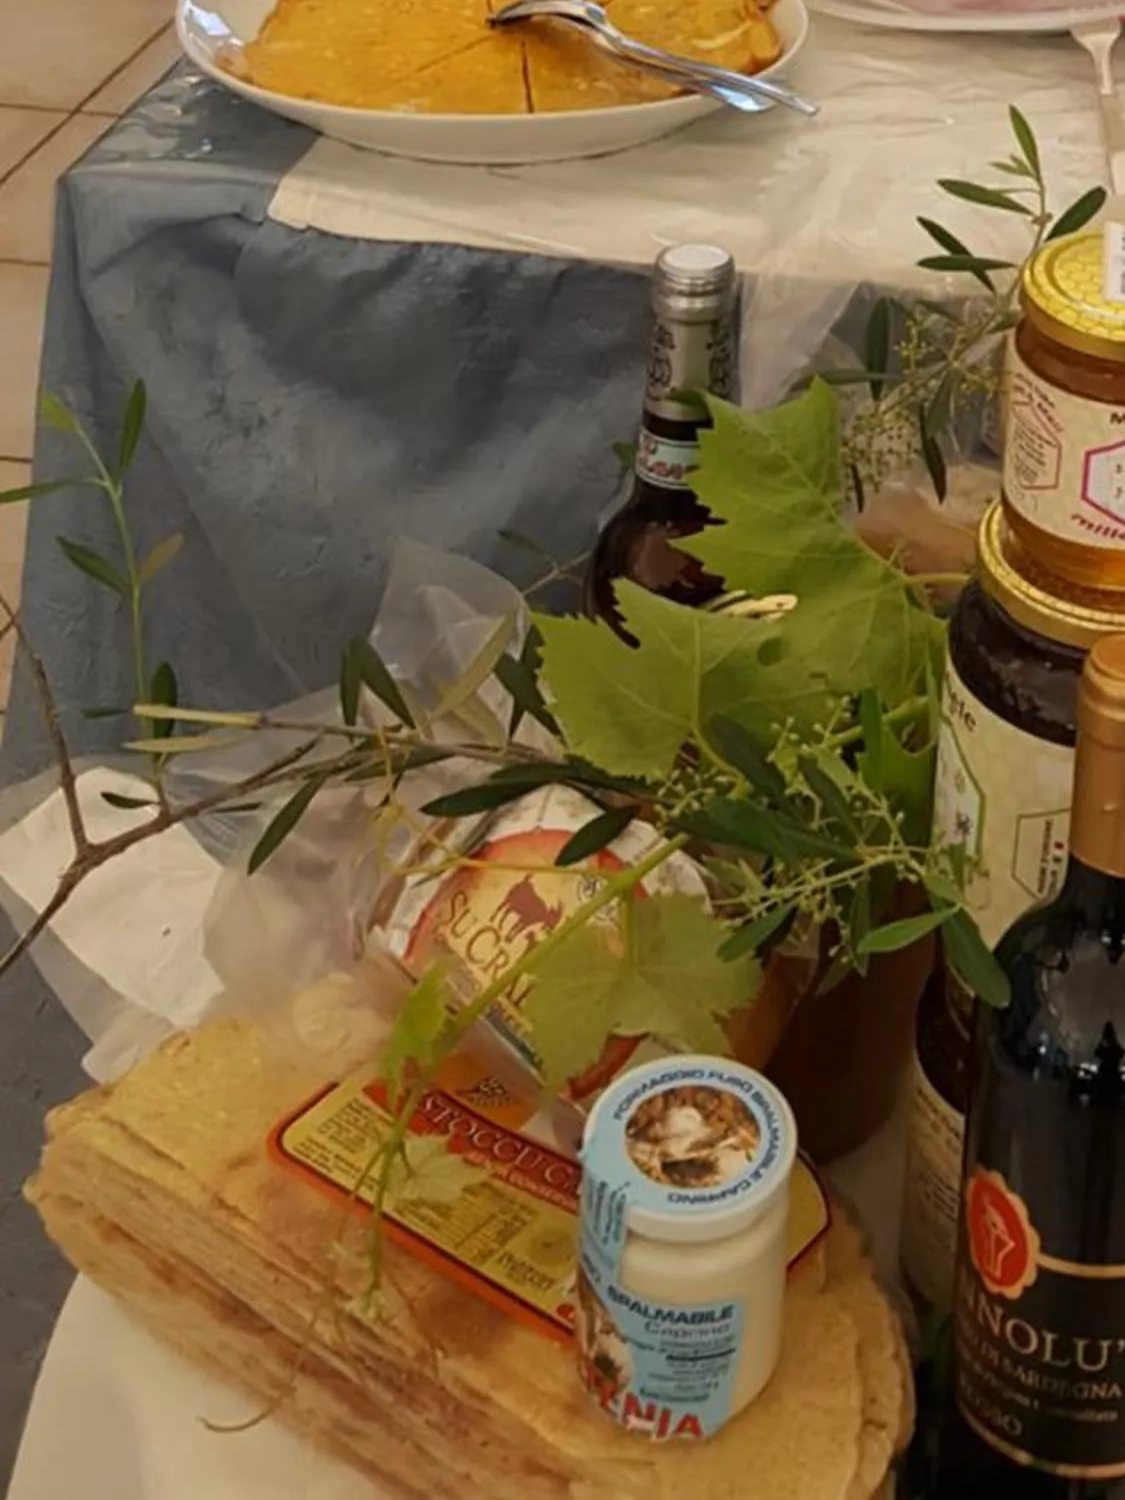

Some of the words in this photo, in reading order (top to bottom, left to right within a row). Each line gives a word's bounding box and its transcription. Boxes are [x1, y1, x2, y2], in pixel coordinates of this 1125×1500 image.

[612, 1069, 705, 1121] FORMAGGIO
[706, 1070, 755, 1094] PURO
[752, 1090, 781, 1184] SPALMABILE
[666, 1180, 752, 1206] CAPRINO
[606, 1284, 735, 1326] SPALMABILE
